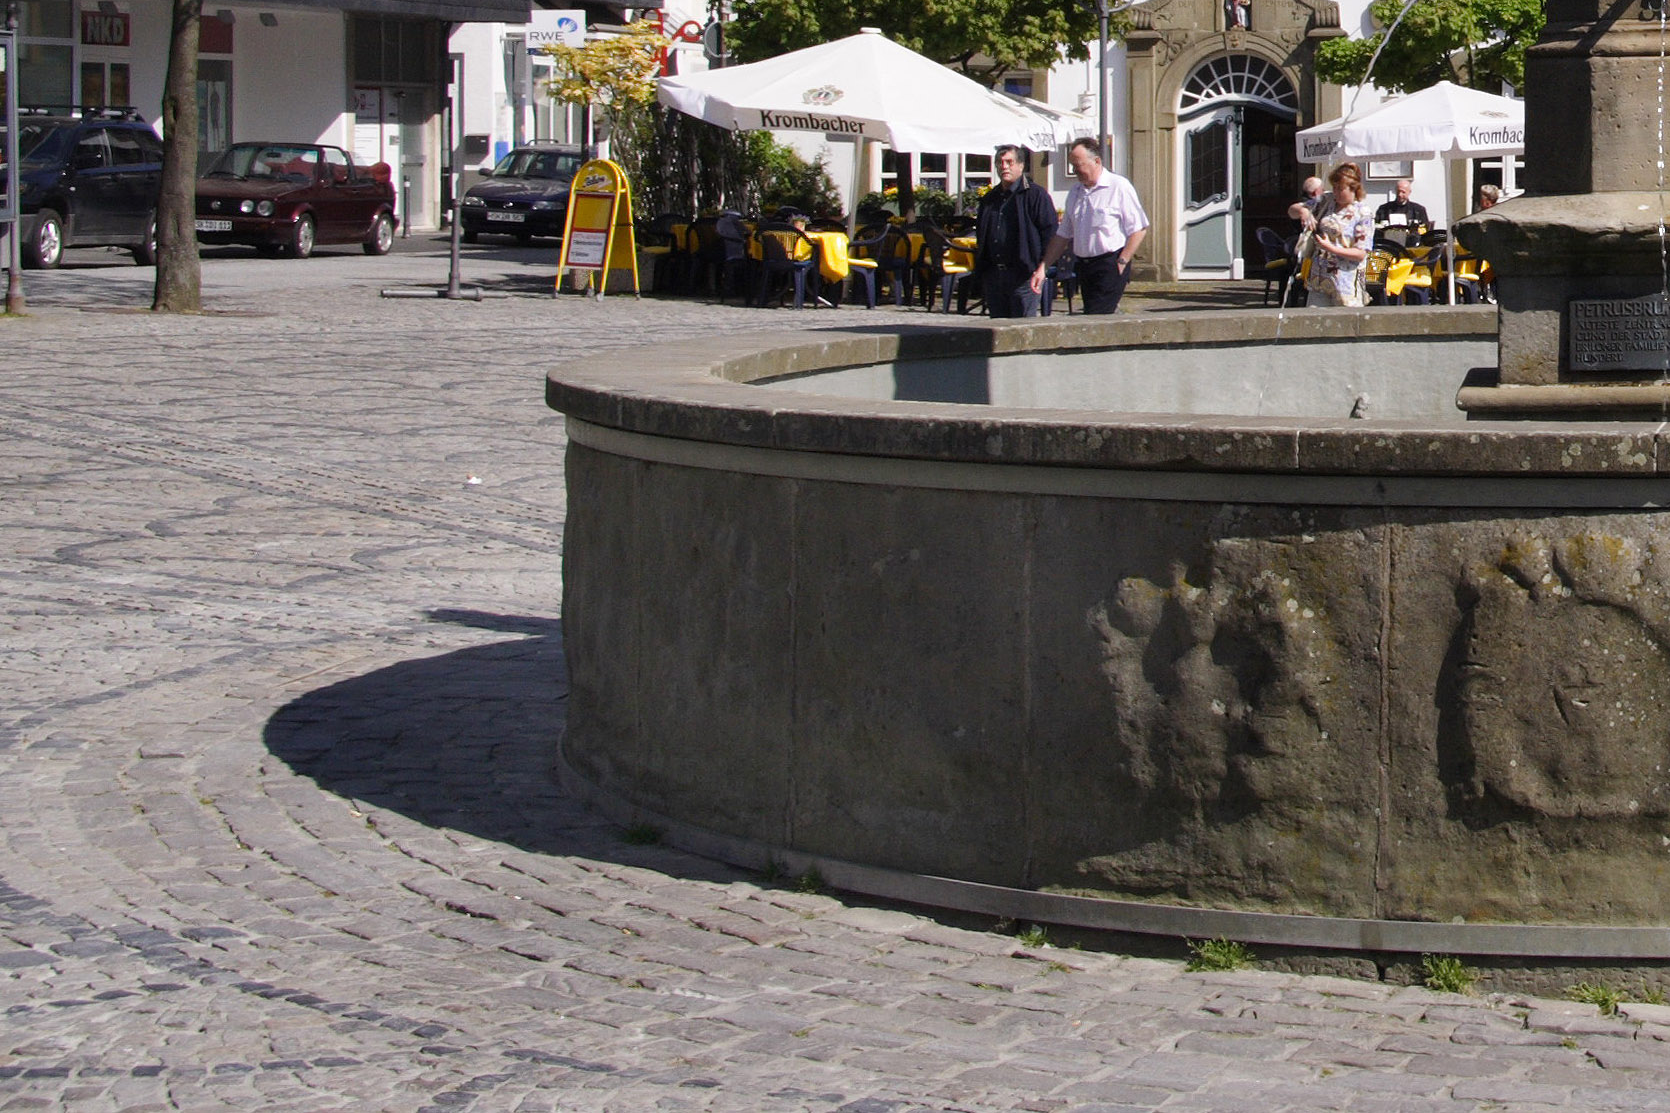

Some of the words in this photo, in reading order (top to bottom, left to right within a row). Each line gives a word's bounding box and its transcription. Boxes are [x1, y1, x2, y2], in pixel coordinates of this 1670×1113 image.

[87, 16, 124, 43] NKD
[529, 31, 565, 41] RWE
[760, 109, 866, 134] Krombacher
[1469, 125, 1525, 145] Krombac
[1611, 331, 1631, 341] DER
